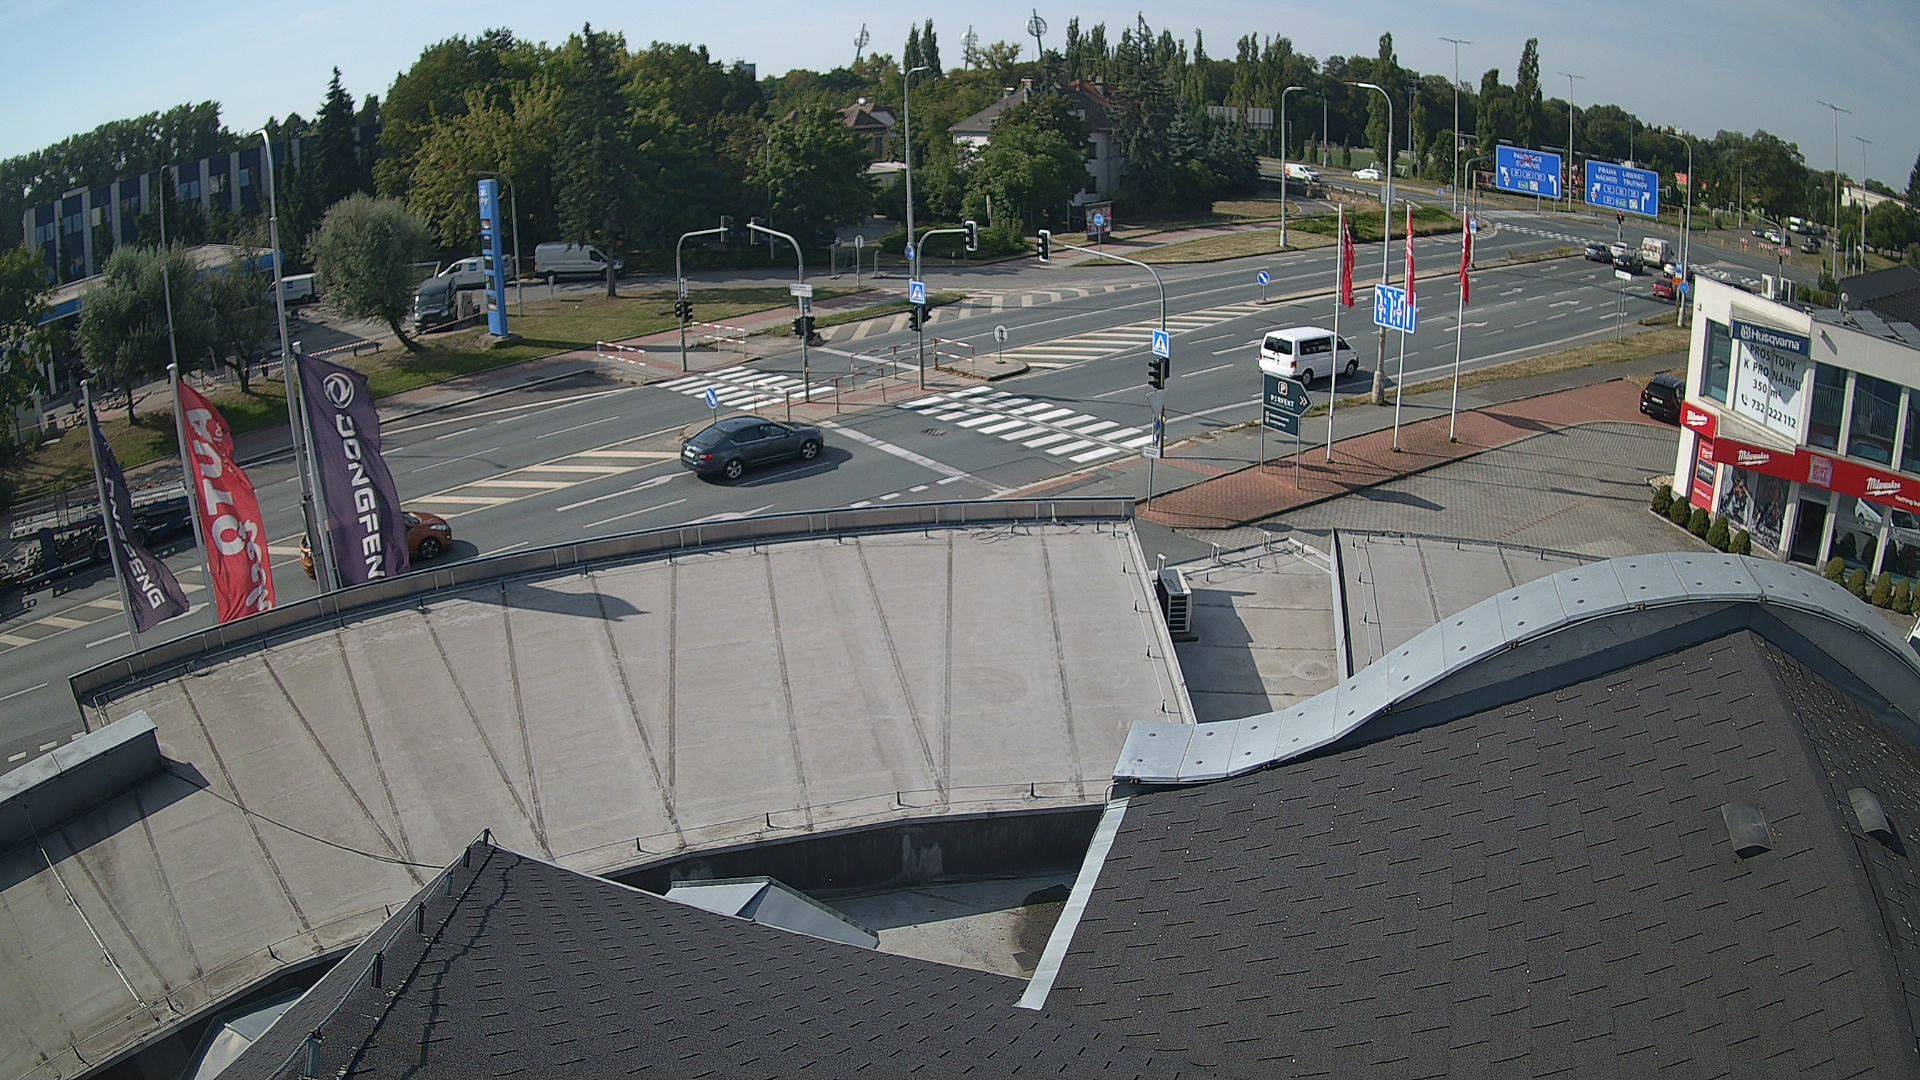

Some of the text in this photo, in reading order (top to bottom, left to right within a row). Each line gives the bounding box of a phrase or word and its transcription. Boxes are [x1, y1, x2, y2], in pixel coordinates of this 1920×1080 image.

[1751, 328, 1800, 351] Husqvarna
[1752, 379, 1767, 393] 350
[1751, 399, 1764, 414] 732
